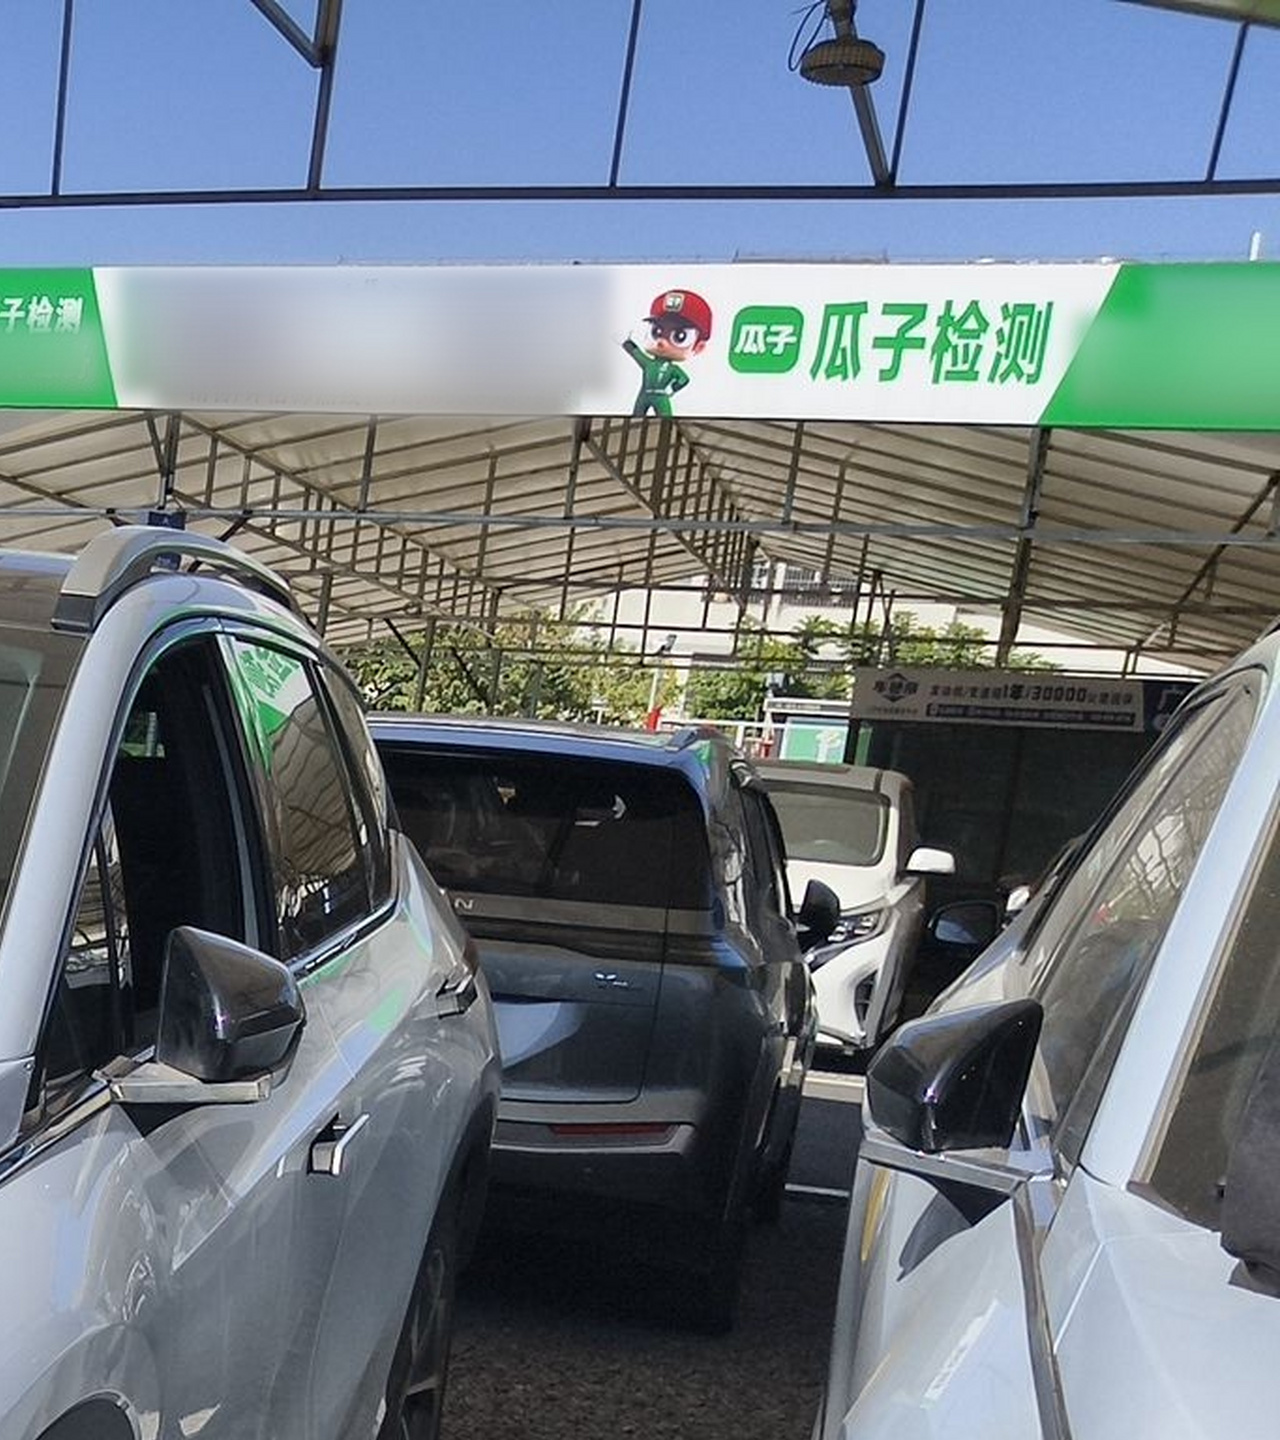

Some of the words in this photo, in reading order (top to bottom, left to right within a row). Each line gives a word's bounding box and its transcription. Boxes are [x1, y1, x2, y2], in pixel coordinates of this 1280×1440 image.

[734, 323, 798, 355] 瓜子
[809, 299, 1054, 384] 瓜子检测
